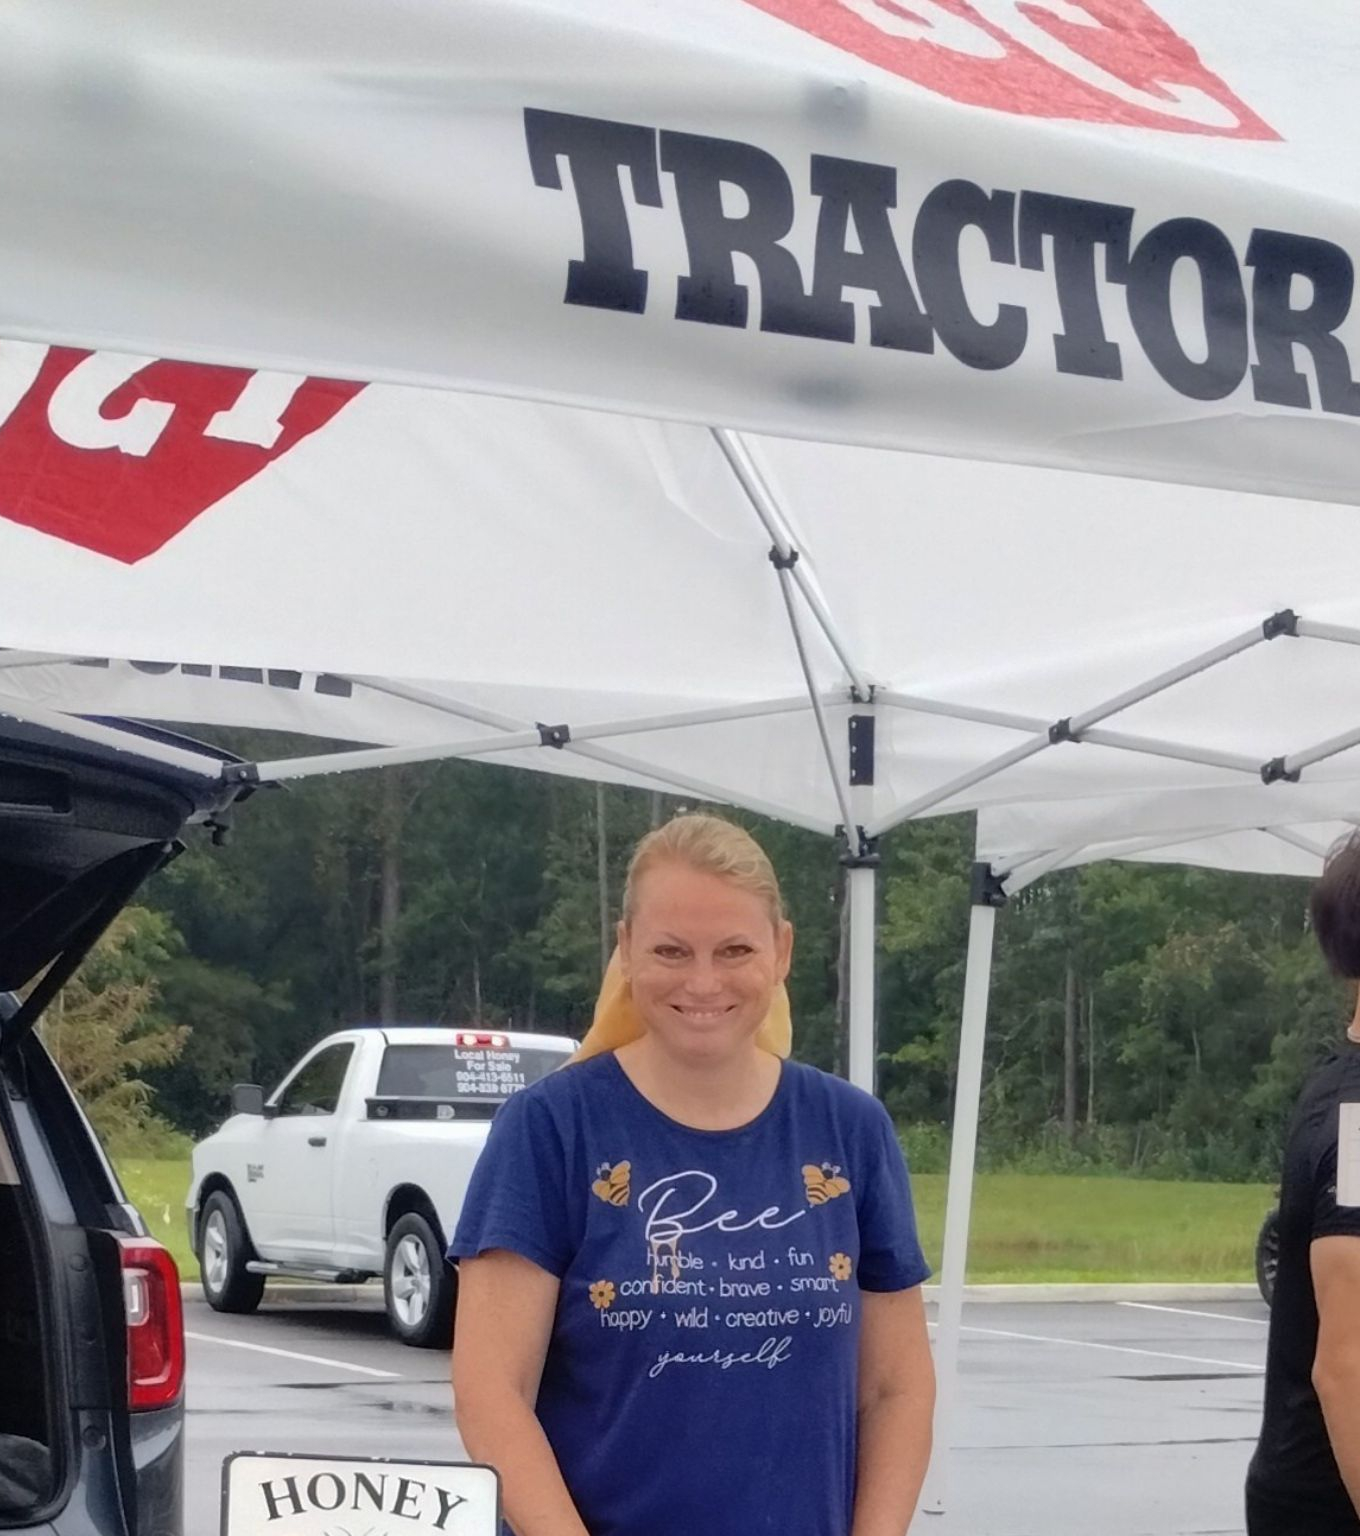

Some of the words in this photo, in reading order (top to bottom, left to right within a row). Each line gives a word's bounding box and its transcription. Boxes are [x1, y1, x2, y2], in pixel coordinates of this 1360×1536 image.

[467, 1061, 485, 1070] For
[488, 1061, 512, 1072] Sale
[638, 1170, 809, 1244] Bee
[646, 1248, 704, 1270] humble
[727, 1250, 766, 1271] kind
[788, 1247, 814, 1267] fun
[620, 1275, 706, 1297] confident
[719, 1277, 770, 1298] brave
[791, 1276, 840, 1293] smart
[600, 1307, 652, 1330] happy
[674, 1307, 708, 1328] wild
[725, 1307, 800, 1328] creative
[649, 1336, 793, 1378] yourself
[259, 1472, 469, 1530] HONEY
